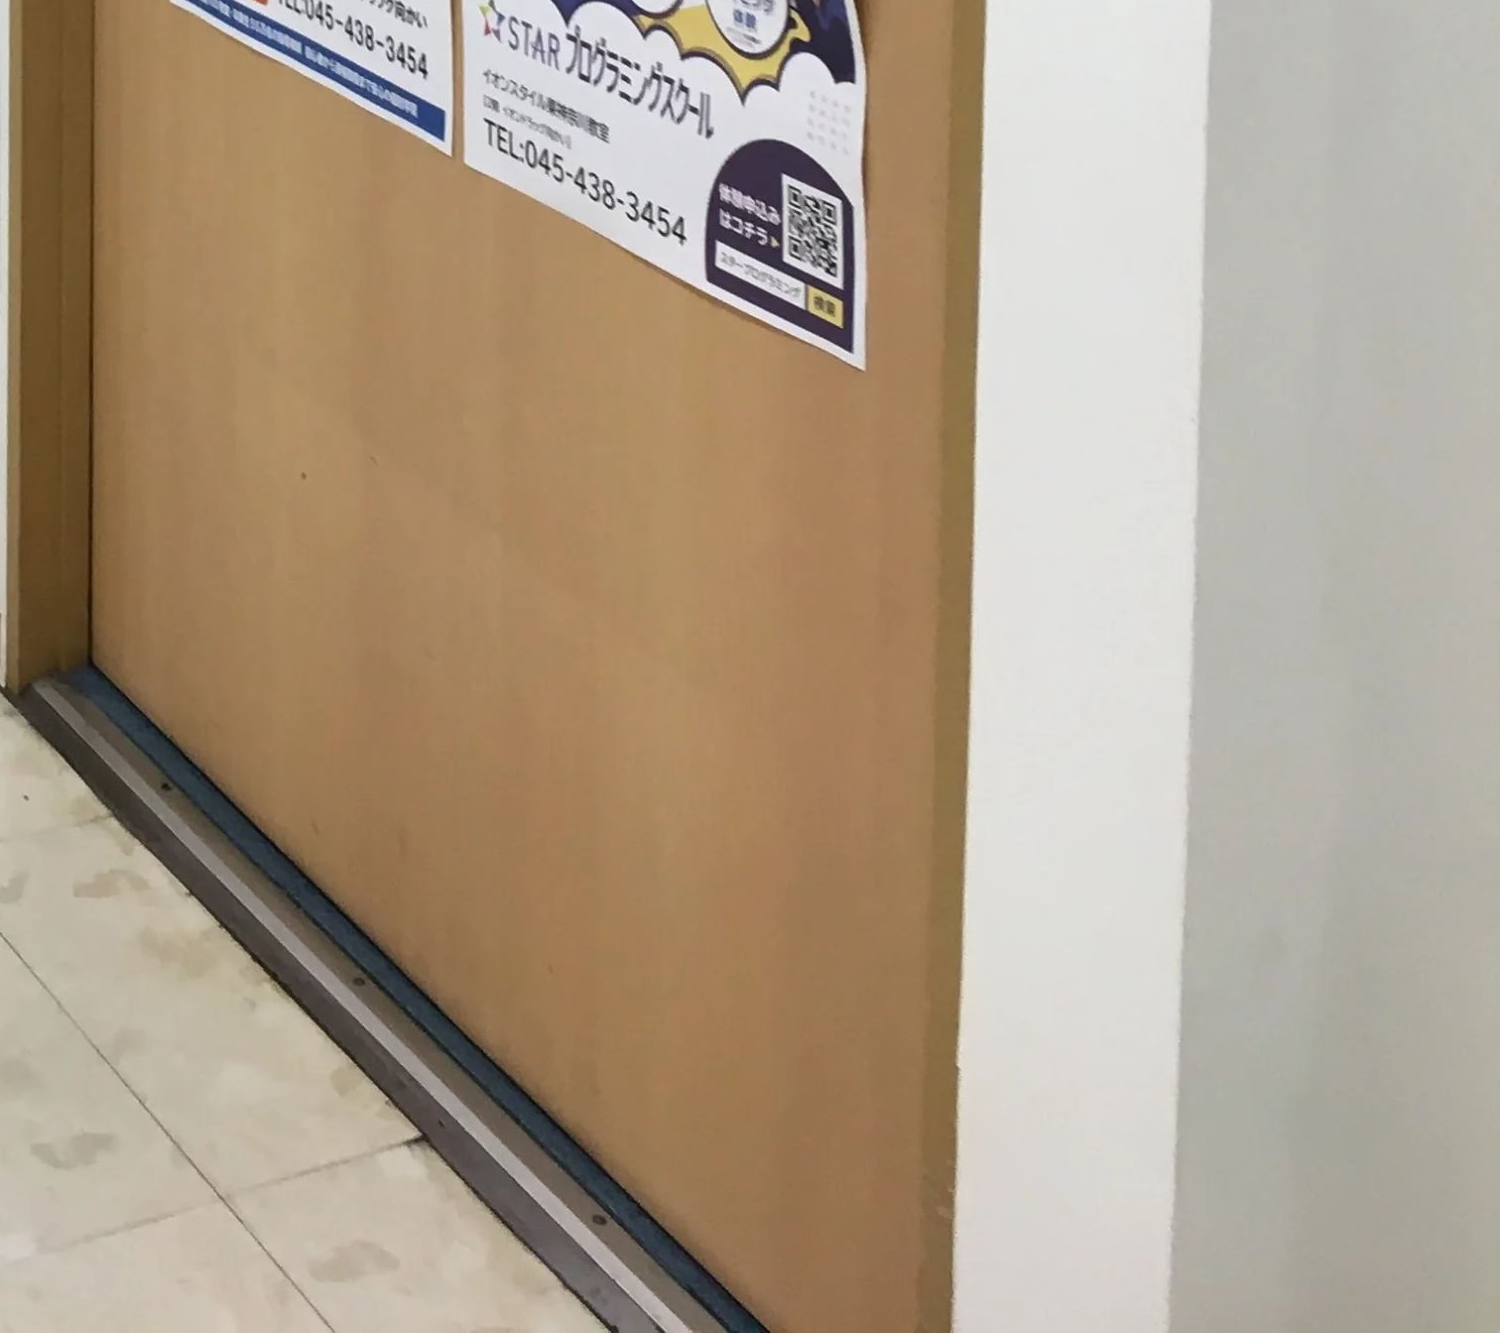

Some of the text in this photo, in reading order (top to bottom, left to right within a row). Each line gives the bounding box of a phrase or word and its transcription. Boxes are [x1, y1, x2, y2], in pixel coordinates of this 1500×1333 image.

[508, 17, 561, 71] STAR
[565, 24, 715, 139] プログラミングスクール
[483, 117, 688, 246] TEL:045-438-3454
